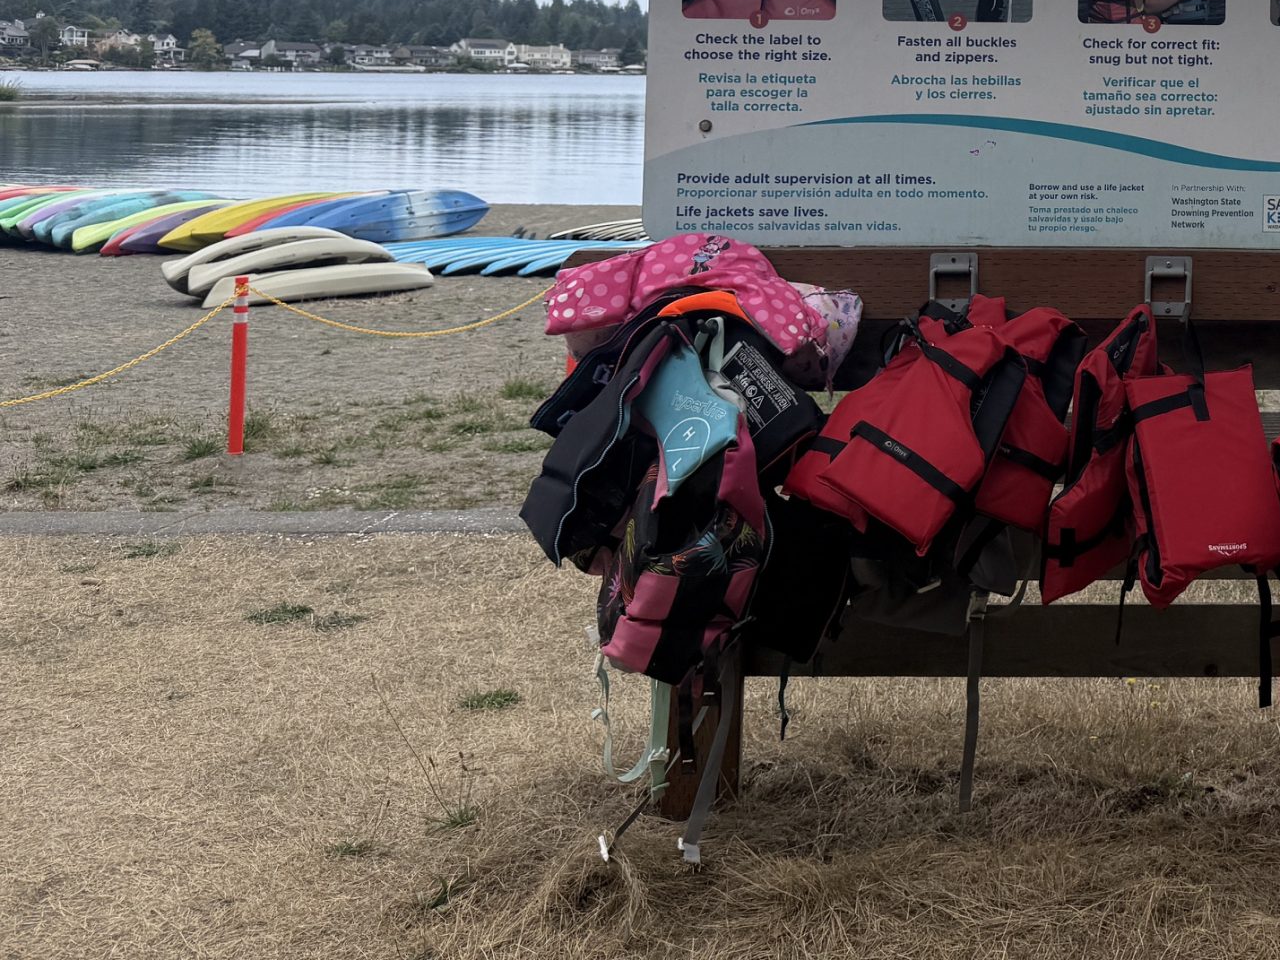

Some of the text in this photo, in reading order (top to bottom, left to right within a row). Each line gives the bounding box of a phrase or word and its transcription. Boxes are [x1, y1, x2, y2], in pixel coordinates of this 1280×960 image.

[696, 34, 821, 45] Check the label to
[898, 36, 1016, 47] Fasten all buckles
[1083, 39, 1220, 50] Check for correct fit:
[684, 49, 831, 62] choose the right size.
[916, 52, 998, 64] and zippers.
[1090, 54, 1212, 67] snug but not tight.
[699, 73, 816, 85] Revisa la etiqueta
[891, 75, 1021, 85] Abrocha las hebillas
[1103, 77, 1199, 89] Verificar que el
[707, 88, 808, 99] para escoger la
[916, 89, 996, 100] y los cierres.
[1083, 91, 1218, 101] tamaño sea correcto:
[711, 101, 802, 111] talla correcta.
[1086, 104, 1215, 117] ajustado sin apretar.
[678, 173, 935, 185] Provide adult supervision at all times.
[677, 188, 757, 198] Proporcionar
[761, 188, 831, 199] supervisión
[835, 188, 873, 197] adulta
[896, 189, 924, 198] todo
[928, 190, 988, 198] momento.
[1172, 198, 1219, 206] Washington
[677, 206, 828, 218] Life jackets save lives.
[1172, 210, 1209, 218] Drowning
[676, 221, 901, 230] Los chalecos salvavidas salvan vidas.
[736, 350, 754, 369] YOUTH
[683, 426, 696, 441] H
[672, 457, 682, 472] L
